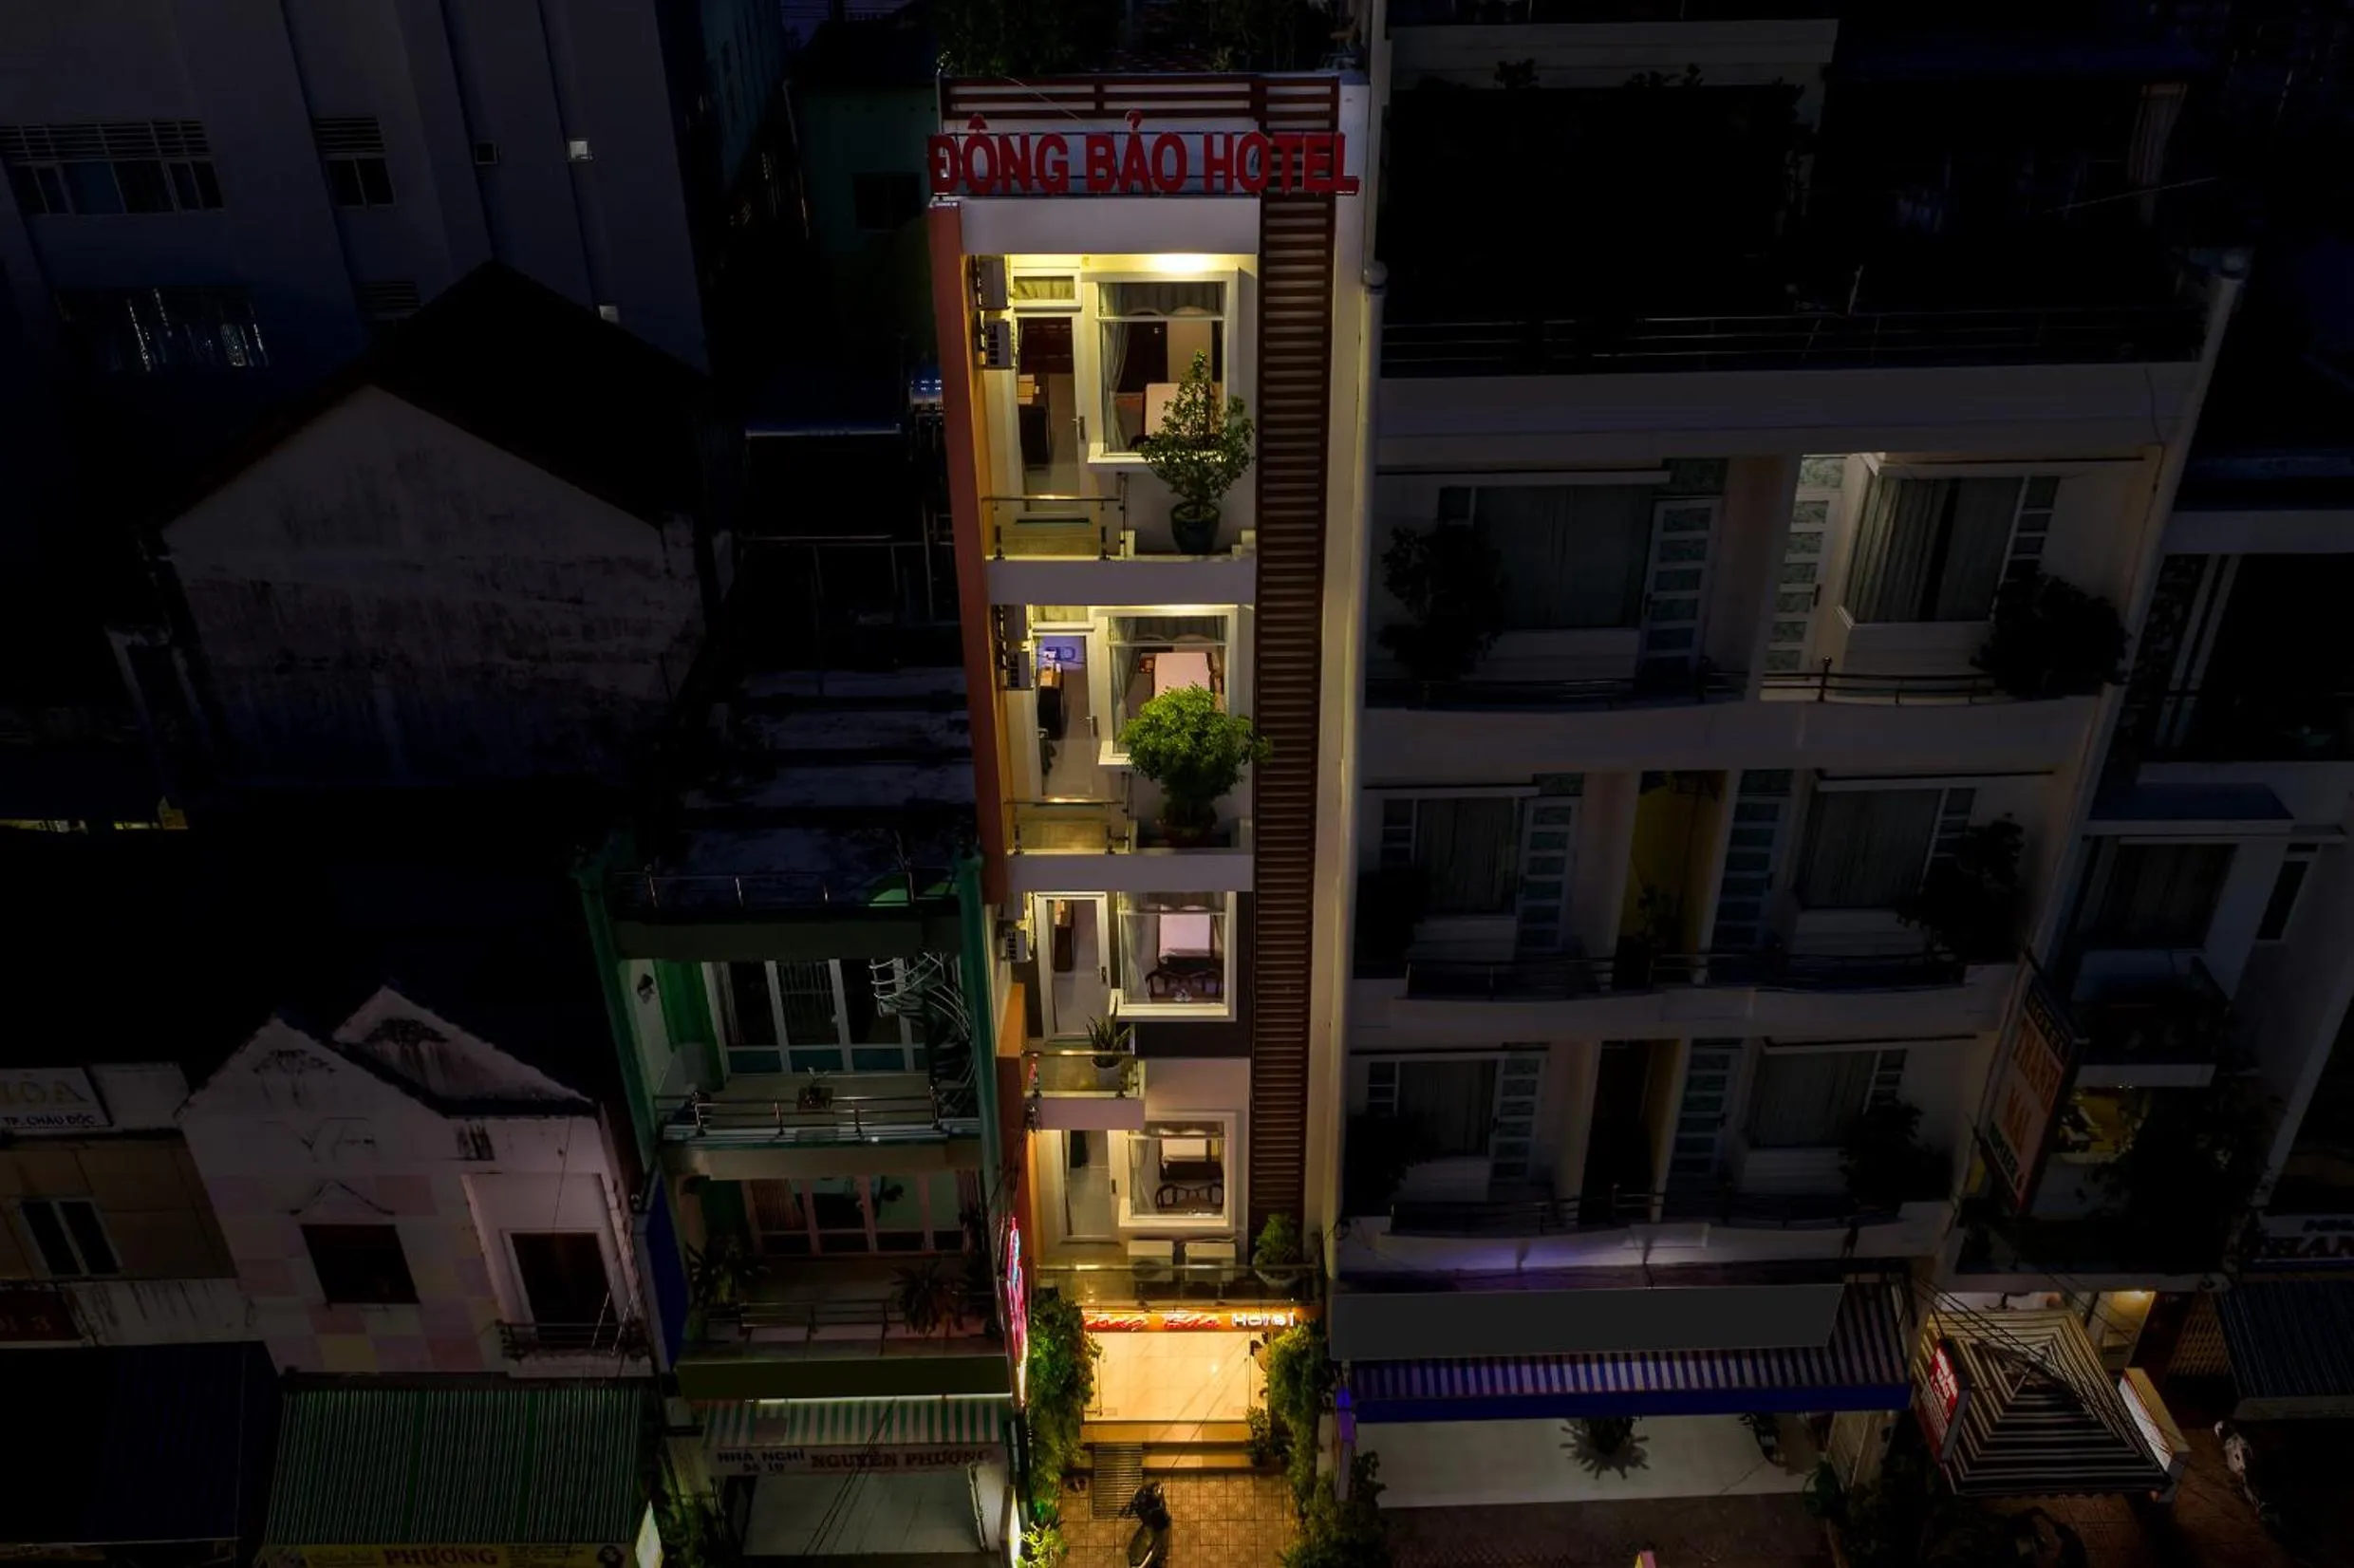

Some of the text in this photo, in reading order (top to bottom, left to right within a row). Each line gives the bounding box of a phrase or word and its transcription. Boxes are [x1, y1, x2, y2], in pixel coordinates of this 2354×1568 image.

[926, 109, 1359, 196] ĐÔNG BẢO HOTEL
